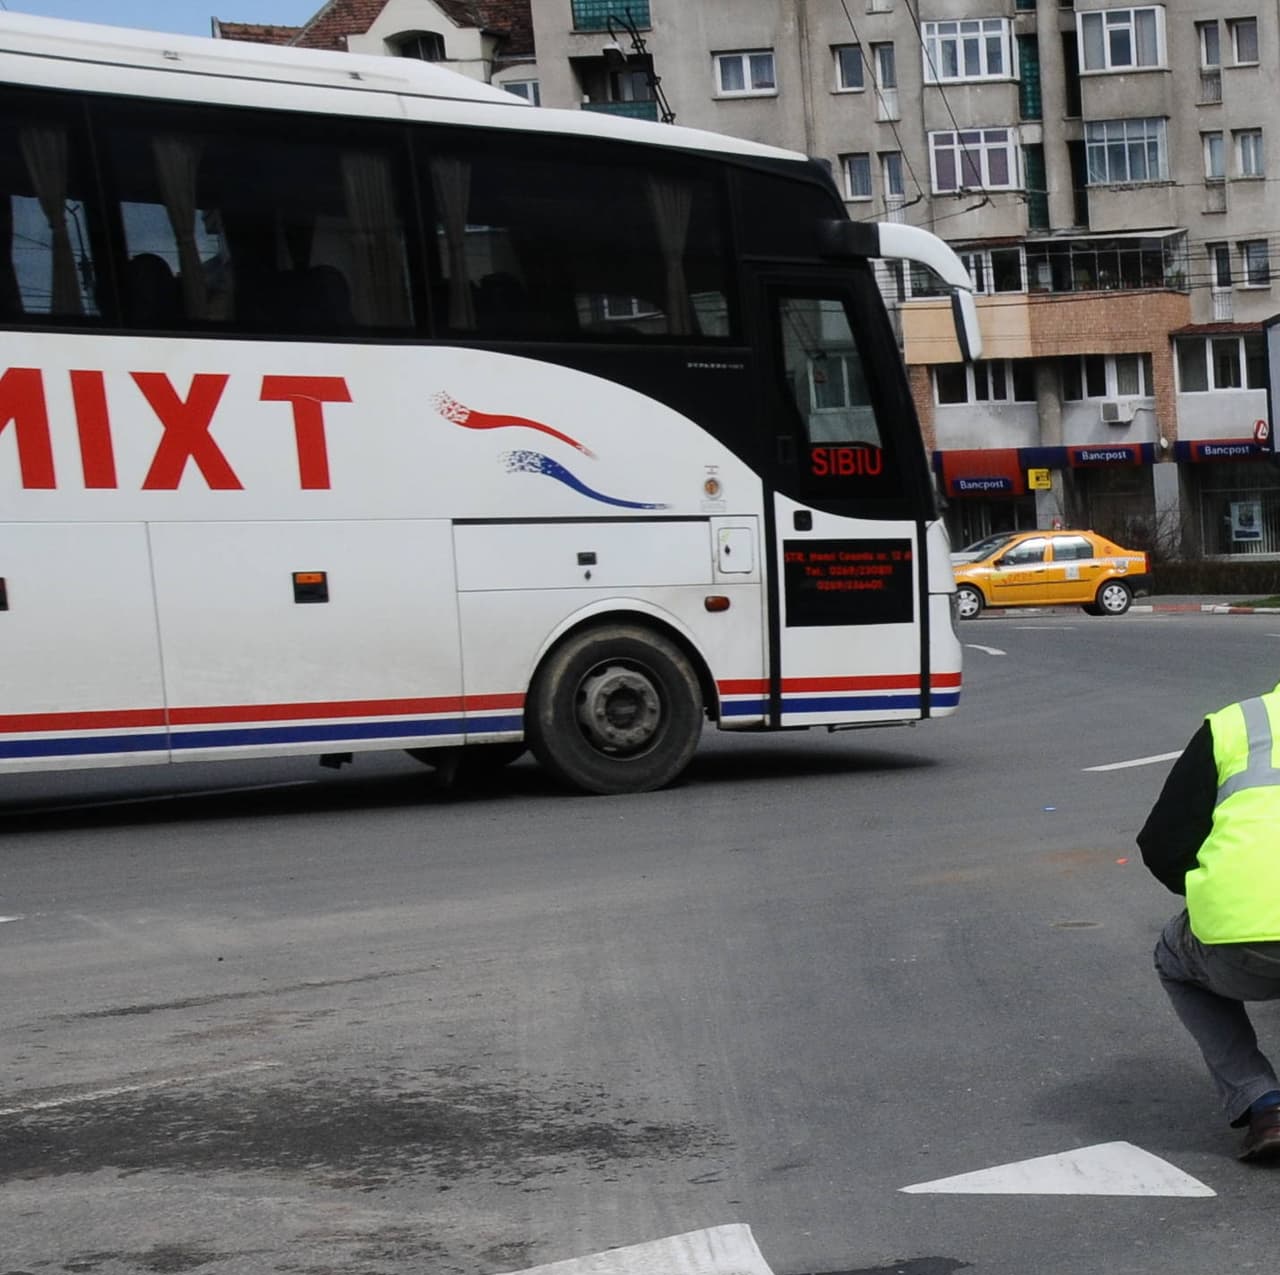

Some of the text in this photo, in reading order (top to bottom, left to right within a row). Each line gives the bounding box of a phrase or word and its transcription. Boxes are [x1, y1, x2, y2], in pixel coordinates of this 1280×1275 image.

[1082, 451, 1127, 461] Bancpost
[1205, 446, 1250, 456] Bancpost
[812, 447, 883, 476] SIBIU
[960, 480, 1004, 491] Bancpost
